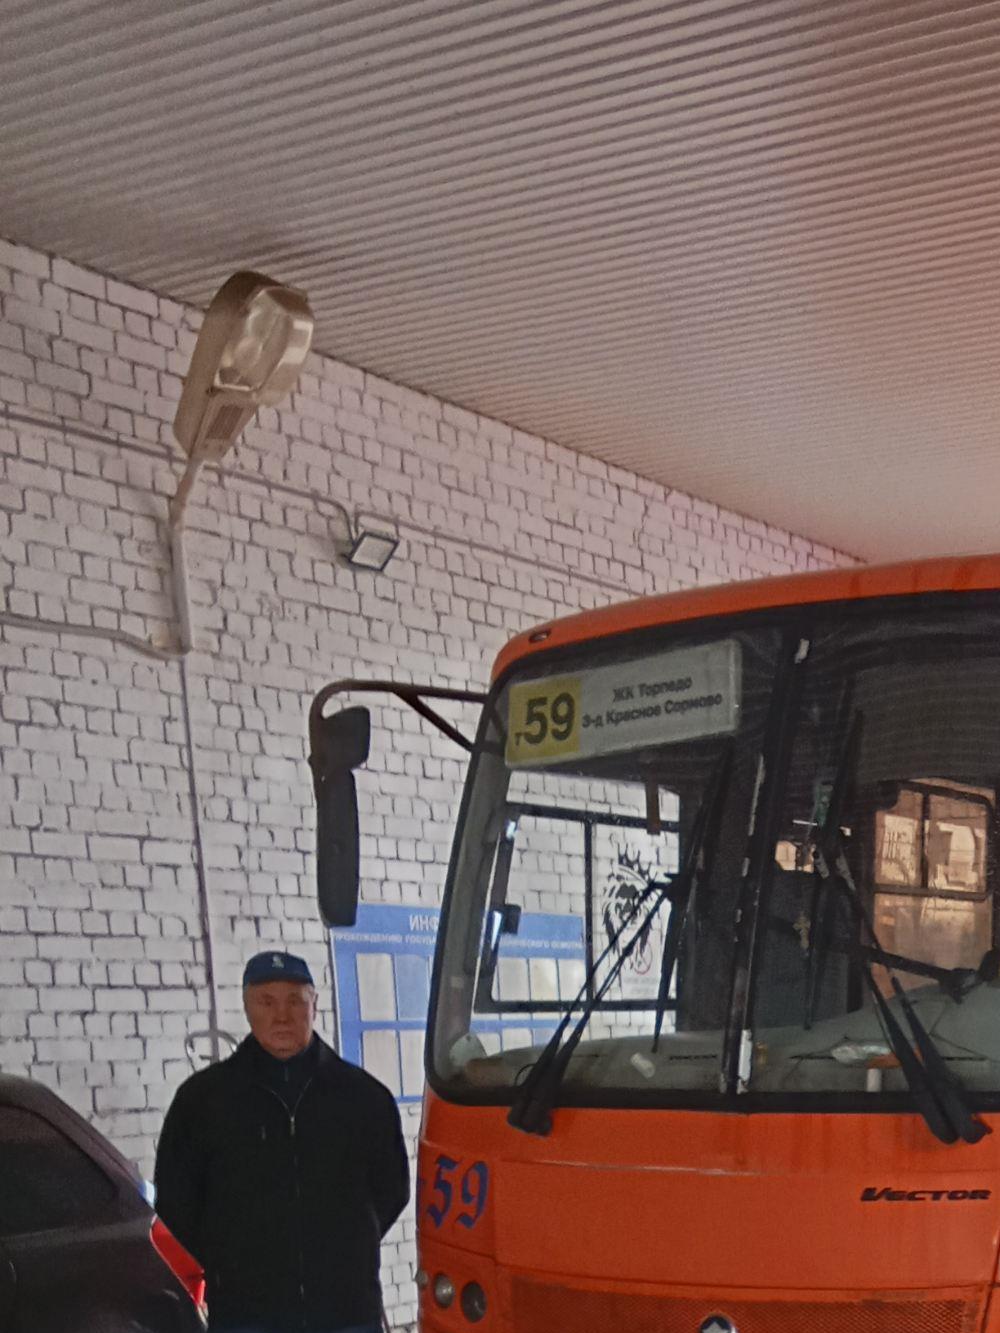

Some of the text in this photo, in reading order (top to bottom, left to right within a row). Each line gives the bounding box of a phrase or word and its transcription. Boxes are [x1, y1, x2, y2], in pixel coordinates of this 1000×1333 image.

[612, 677, 693, 702] ЖК Торпедо
[606, 704, 661, 727] Красное
[665, 693, 723, 716] Сормово
